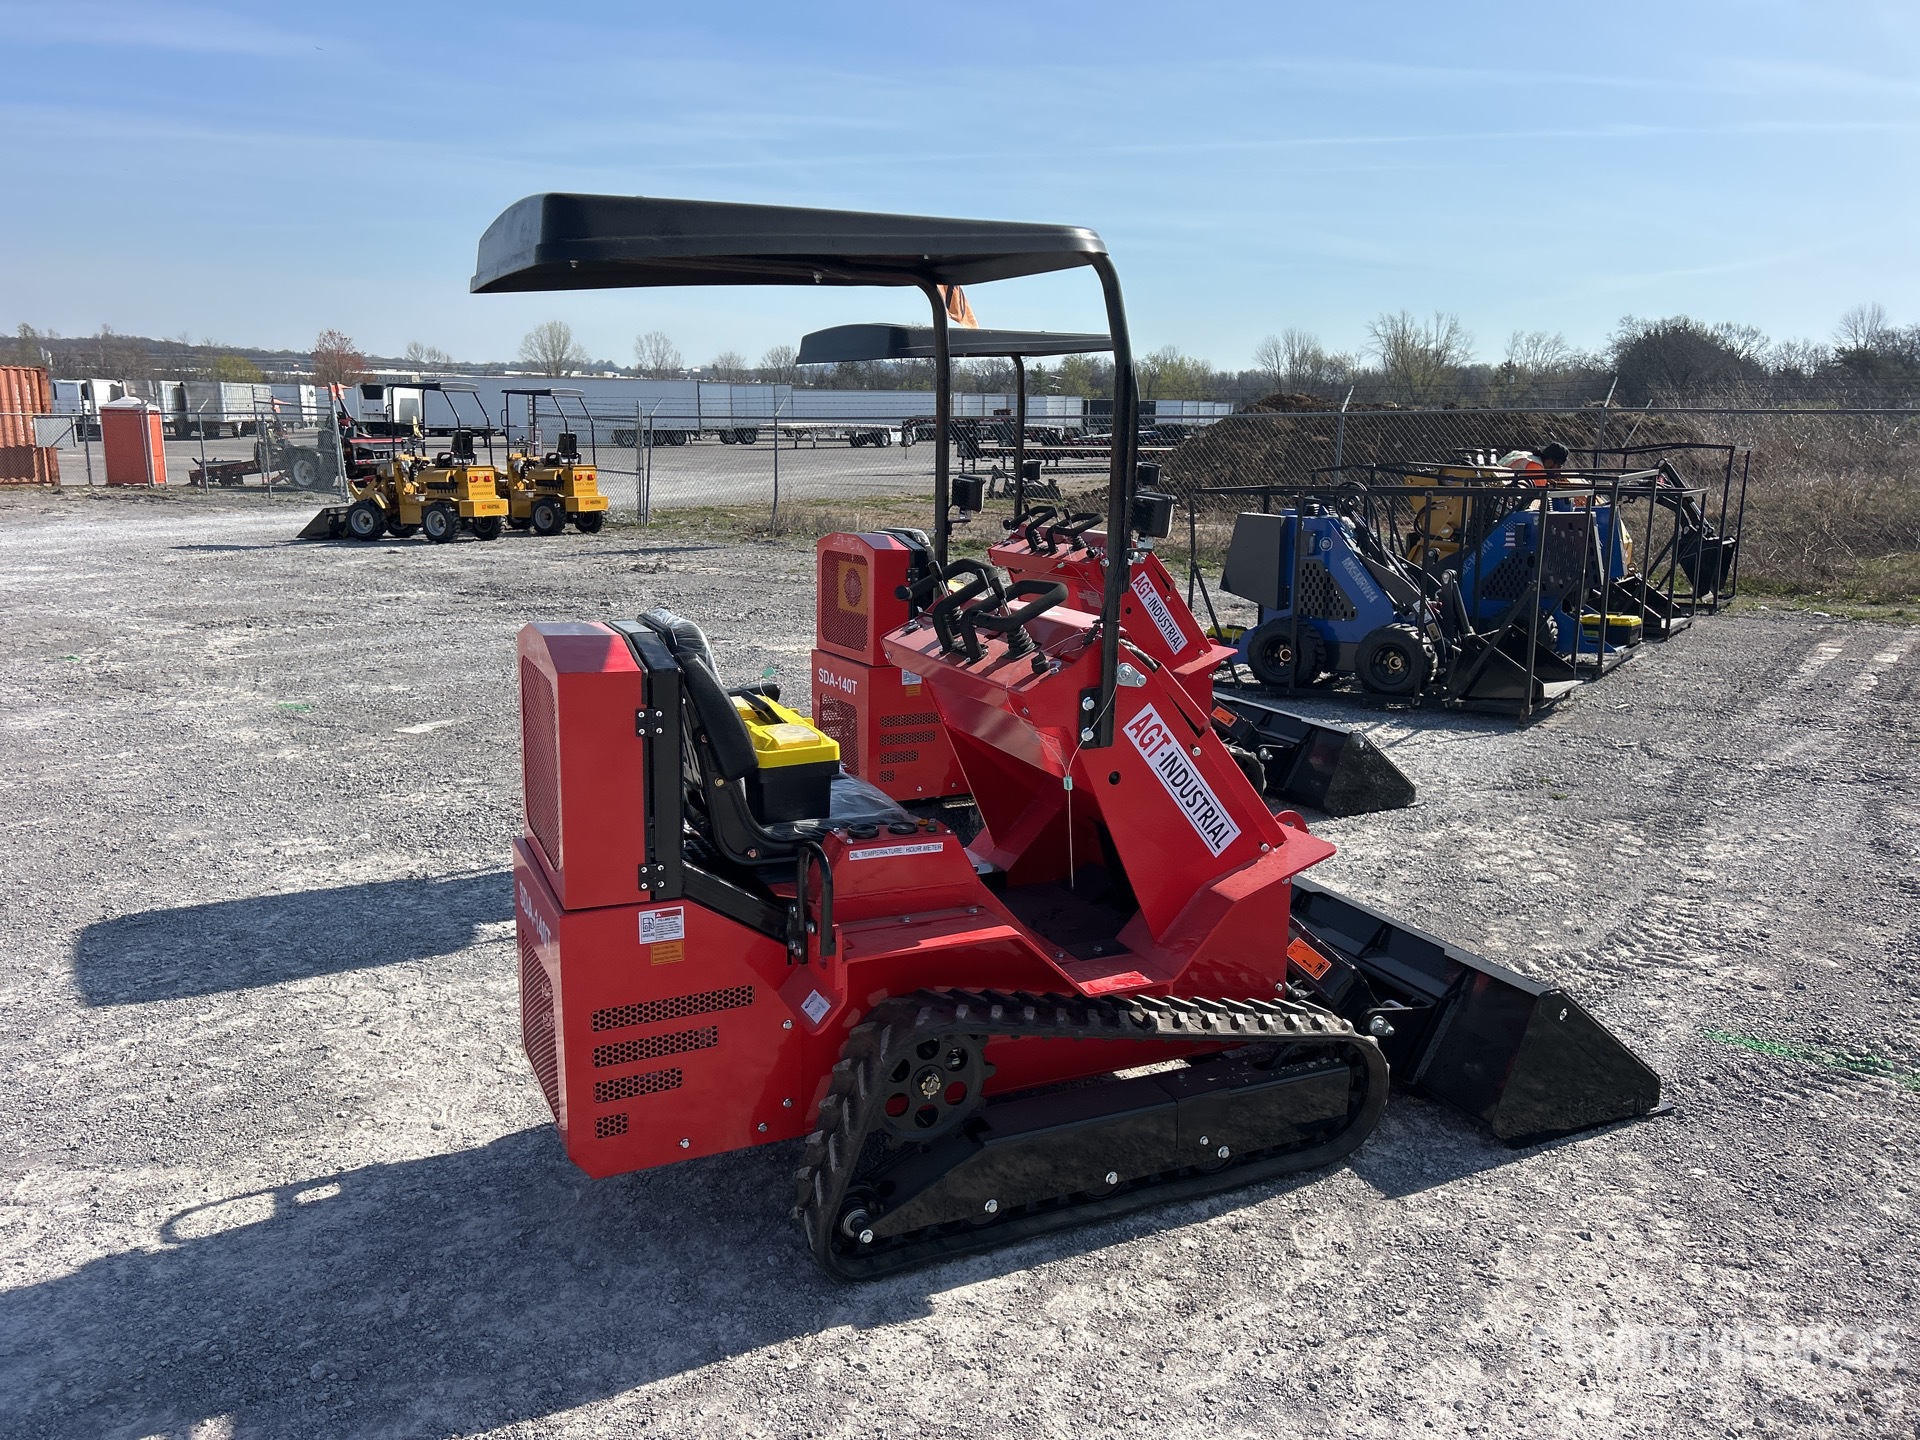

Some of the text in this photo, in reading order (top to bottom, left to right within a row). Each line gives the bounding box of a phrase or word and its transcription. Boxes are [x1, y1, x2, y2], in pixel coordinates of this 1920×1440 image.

[1462, 540, 1494, 575] MX-MW14
[818, 667, 858, 696] SDA-140T
[860, 847, 903, 858] TEMPERATURE
[905, 843, 942, 853] HOUR METER
